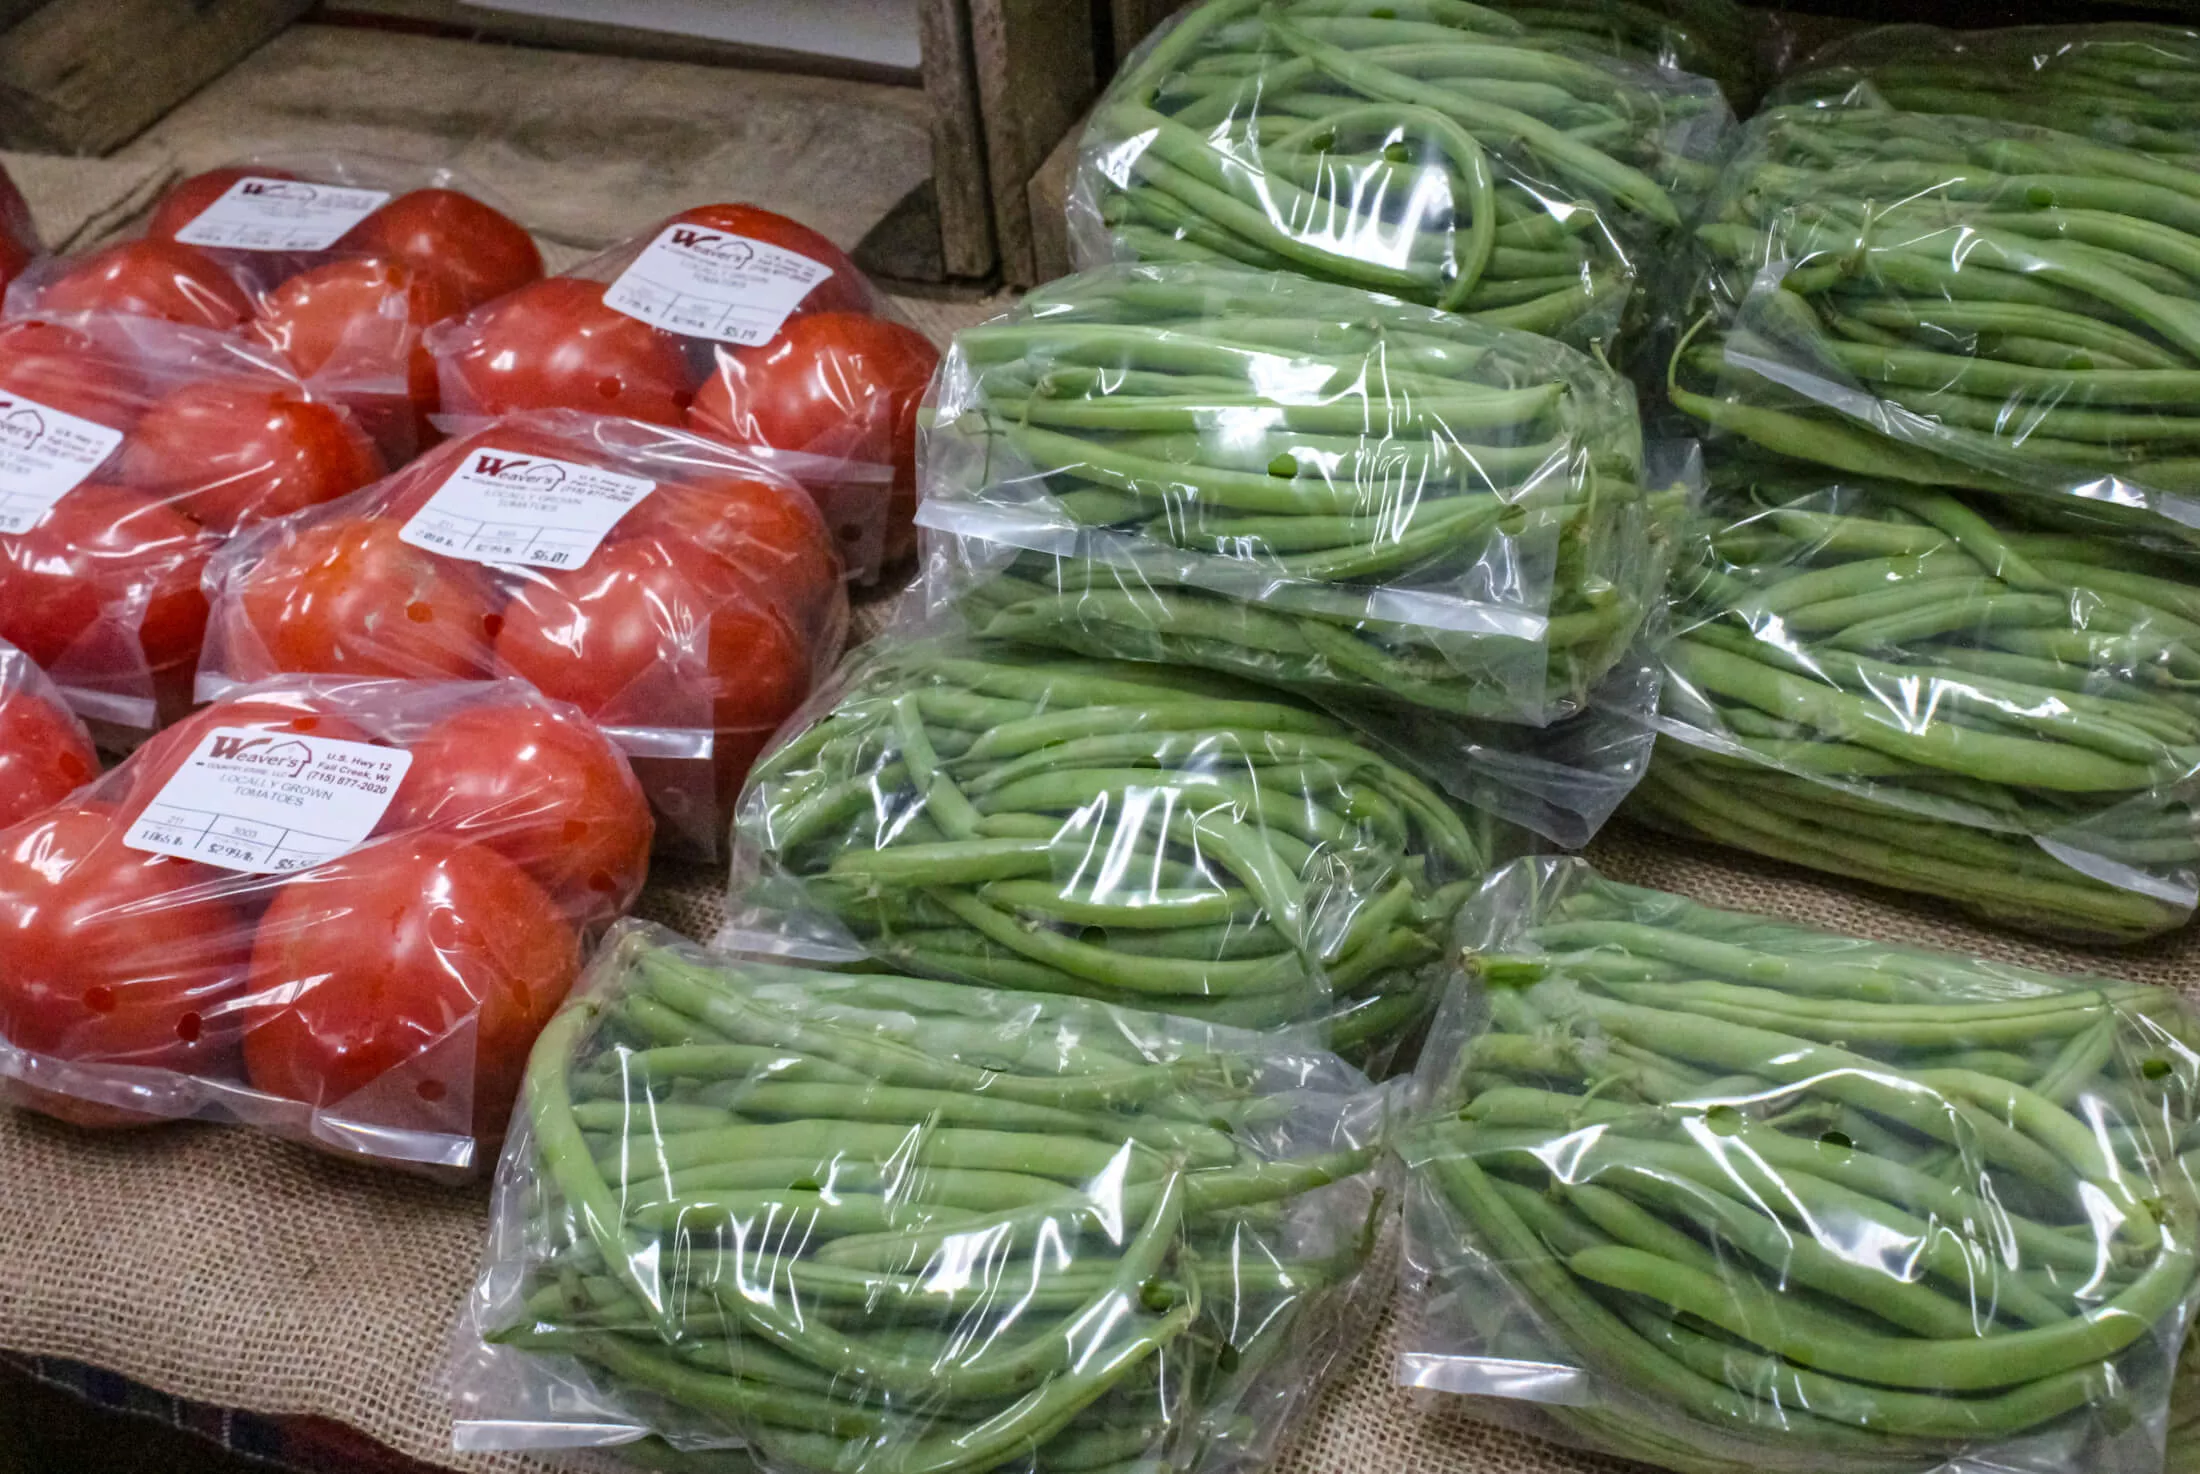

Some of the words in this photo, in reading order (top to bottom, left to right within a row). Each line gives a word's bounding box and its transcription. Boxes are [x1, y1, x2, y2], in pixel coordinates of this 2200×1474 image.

[671, 229, 742, 262] Weaver's
[474, 455, 554, 485] Weaver's
[209, 735, 298, 768] Weaver's
[327, 753, 347, 762] U.S.
[352, 757, 376, 769] Hwy
[380, 762, 393, 771] 12
[307, 771, 336, 784] (715)
[337, 777, 388, 794] 877-2020
[317, 761, 338, 771] Fall
[339, 766, 371, 780] Creek,
[376, 773, 391, 782] WI
[219, 773, 279, 792] LOCALLY
[281, 781, 335, 801] GROWN
[233, 786, 305, 807] TOMATOES
